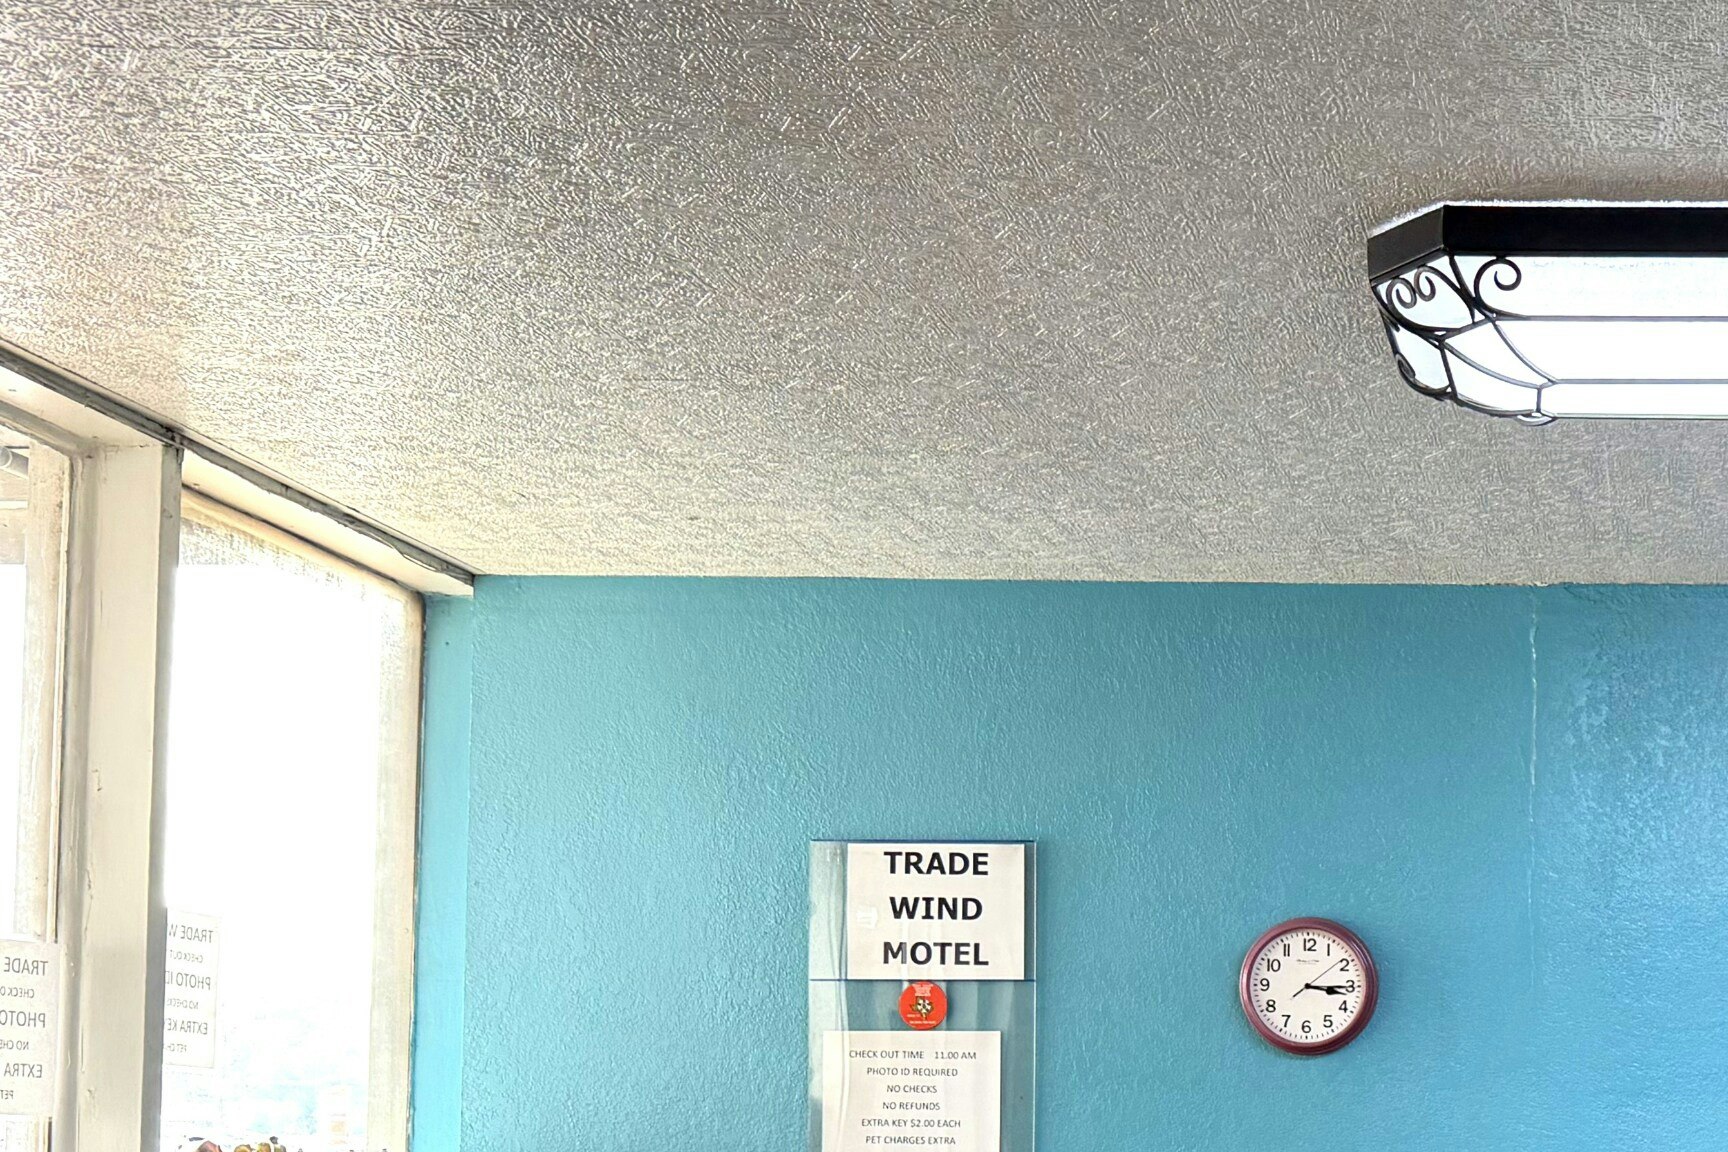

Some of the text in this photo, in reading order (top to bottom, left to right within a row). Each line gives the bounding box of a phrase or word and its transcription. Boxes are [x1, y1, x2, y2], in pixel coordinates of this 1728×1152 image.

[883, 851, 989, 876] TRADE
[888, 896, 983, 920] WIND
[1283, 943, 1291, 957] 11
[1303, 938, 1317, 952] 12
[883, 941, 989, 966] MOTEL
[1266, 958, 1281, 972] 10
[1339, 958, 1350, 972] 2
[1259, 978, 1270, 992] 9
[1345, 979, 1356, 993] 3
[1265, 999, 1277, 1013] 8
[1338, 1000, 1349, 1014] 4
[1281, 1014, 1291, 1028] 7
[1301, 1020, 1312, 1034] 6
[1323, 1014, 1334, 1029] 5
[849, 1050, 878, 1059] CHECK
[880, 1050, 899, 1059] OUT
[902, 1050, 924, 1059] TIME
[960, 1051, 977, 1060] AM
[866, 1067, 958, 1077] PHOTO ID REQUIRED
[886, 1084, 938, 1093] NO CHECKS
[882, 1101, 941, 1111] NO REFUNDS
[861, 1118, 961, 1128] EXTRA KEY $2.00 EACH
[865, 1135, 956, 1145] PET CHARGES EXTRA
